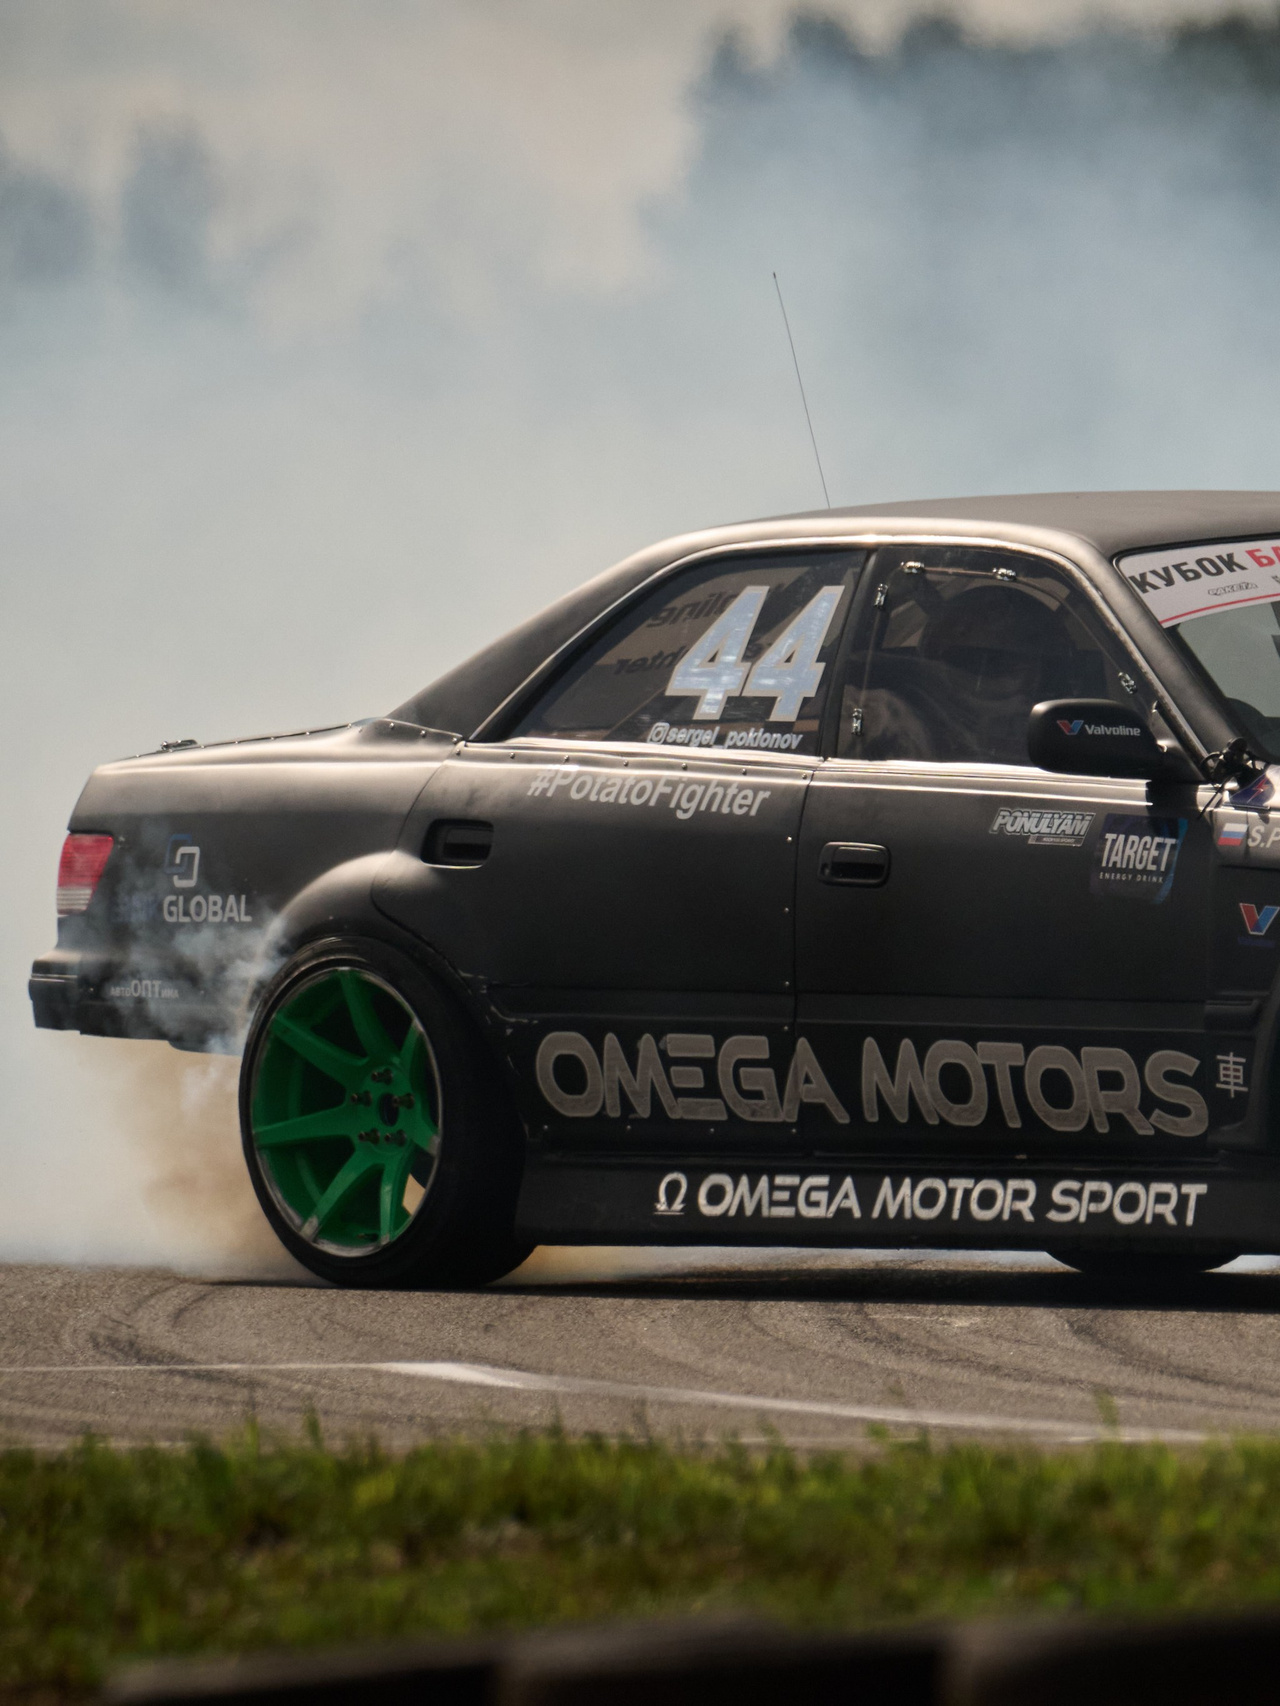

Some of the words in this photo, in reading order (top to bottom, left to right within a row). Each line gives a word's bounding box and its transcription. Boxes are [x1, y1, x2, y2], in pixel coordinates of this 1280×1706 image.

[1129, 552, 1248, 594] КУБОК
[664, 585, 845, 722] 44
[1084, 723, 1141, 737] Valvoline
[526, 769, 771, 820] #PotatoFighter
[990, 809, 1095, 836] PONULYAM
[1101, 833, 1177, 872] TARGET
[1099, 871, 1133, 881] ENERGY
[1136, 874, 1164, 884] DRINK
[162, 893, 253, 924] GLOBAL
[535, 1031, 850, 1124] OMEGA
[861, 1035, 1209, 1137] MOTORS
[1215, 1051, 1249, 1099] 車
[698, 1173, 863, 1219] OMEGA
[871, 1175, 1036, 1223] MOTOR
[1045, 1180, 1209, 1227] SPORT
